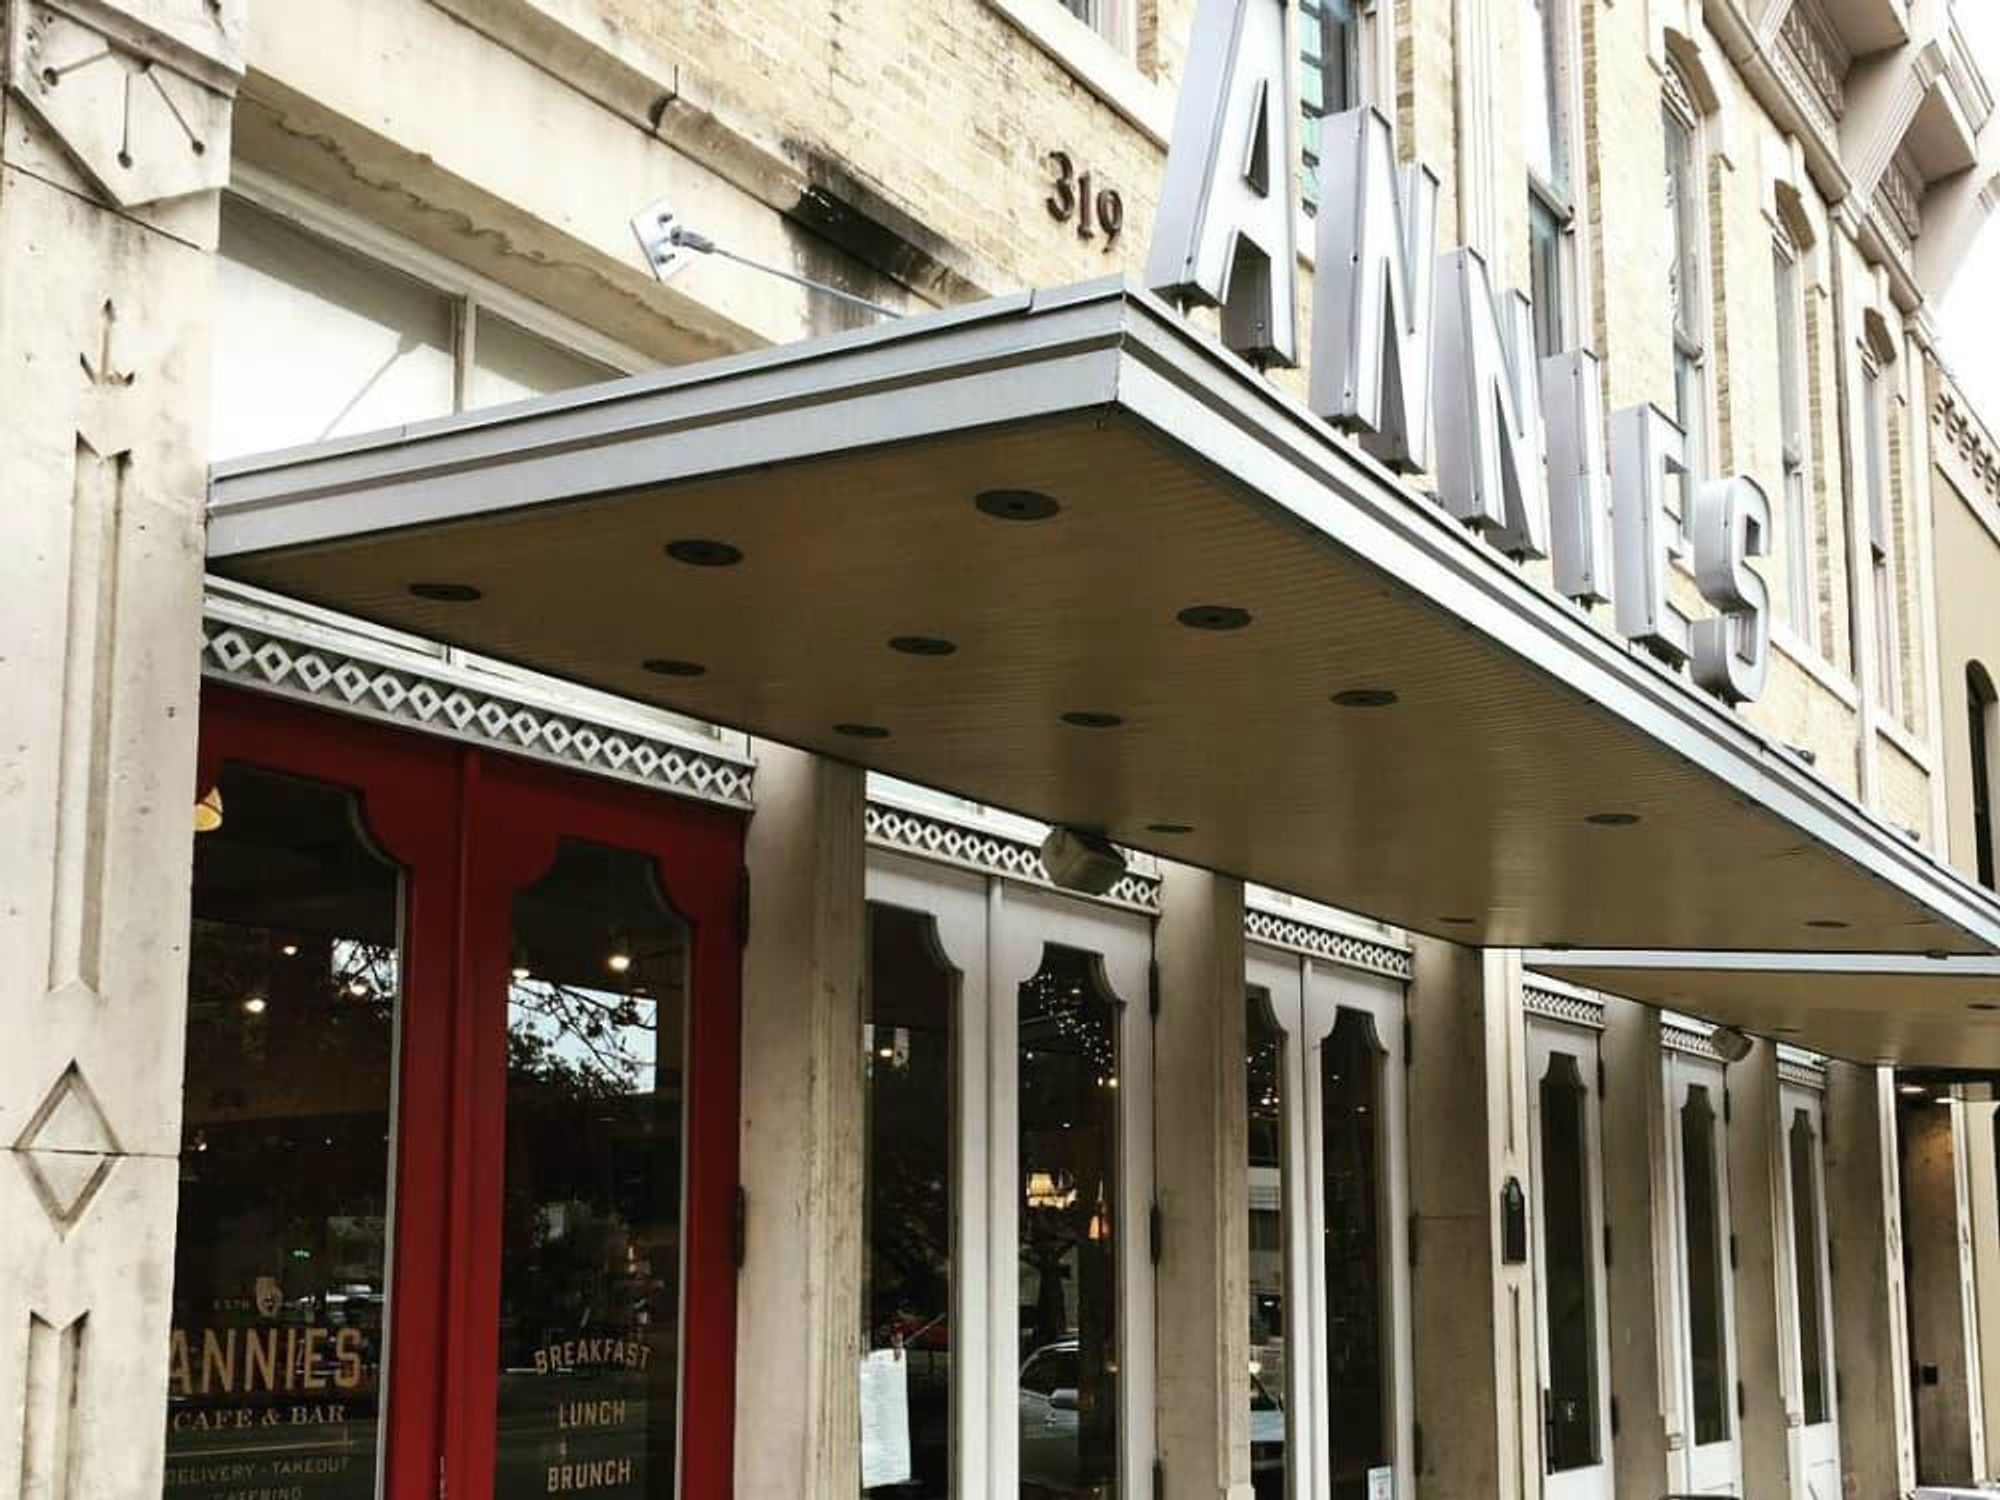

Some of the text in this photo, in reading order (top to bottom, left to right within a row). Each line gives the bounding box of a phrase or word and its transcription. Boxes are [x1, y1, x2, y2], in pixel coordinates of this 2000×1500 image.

[1046, 151, 1123, 254] 319
[1147, 0, 1772, 703] ANNIES
[169, 1327, 363, 1395] ANNIES
[533, 1338, 651, 1375] BREAKFAST
[173, 1404, 346, 1432] CAFE & BAR
[558, 1400, 626, 1429] LUNCH
[272, 1455, 350, 1475] TAKEOUT
[547, 1458, 632, 1493] BRUNCH
